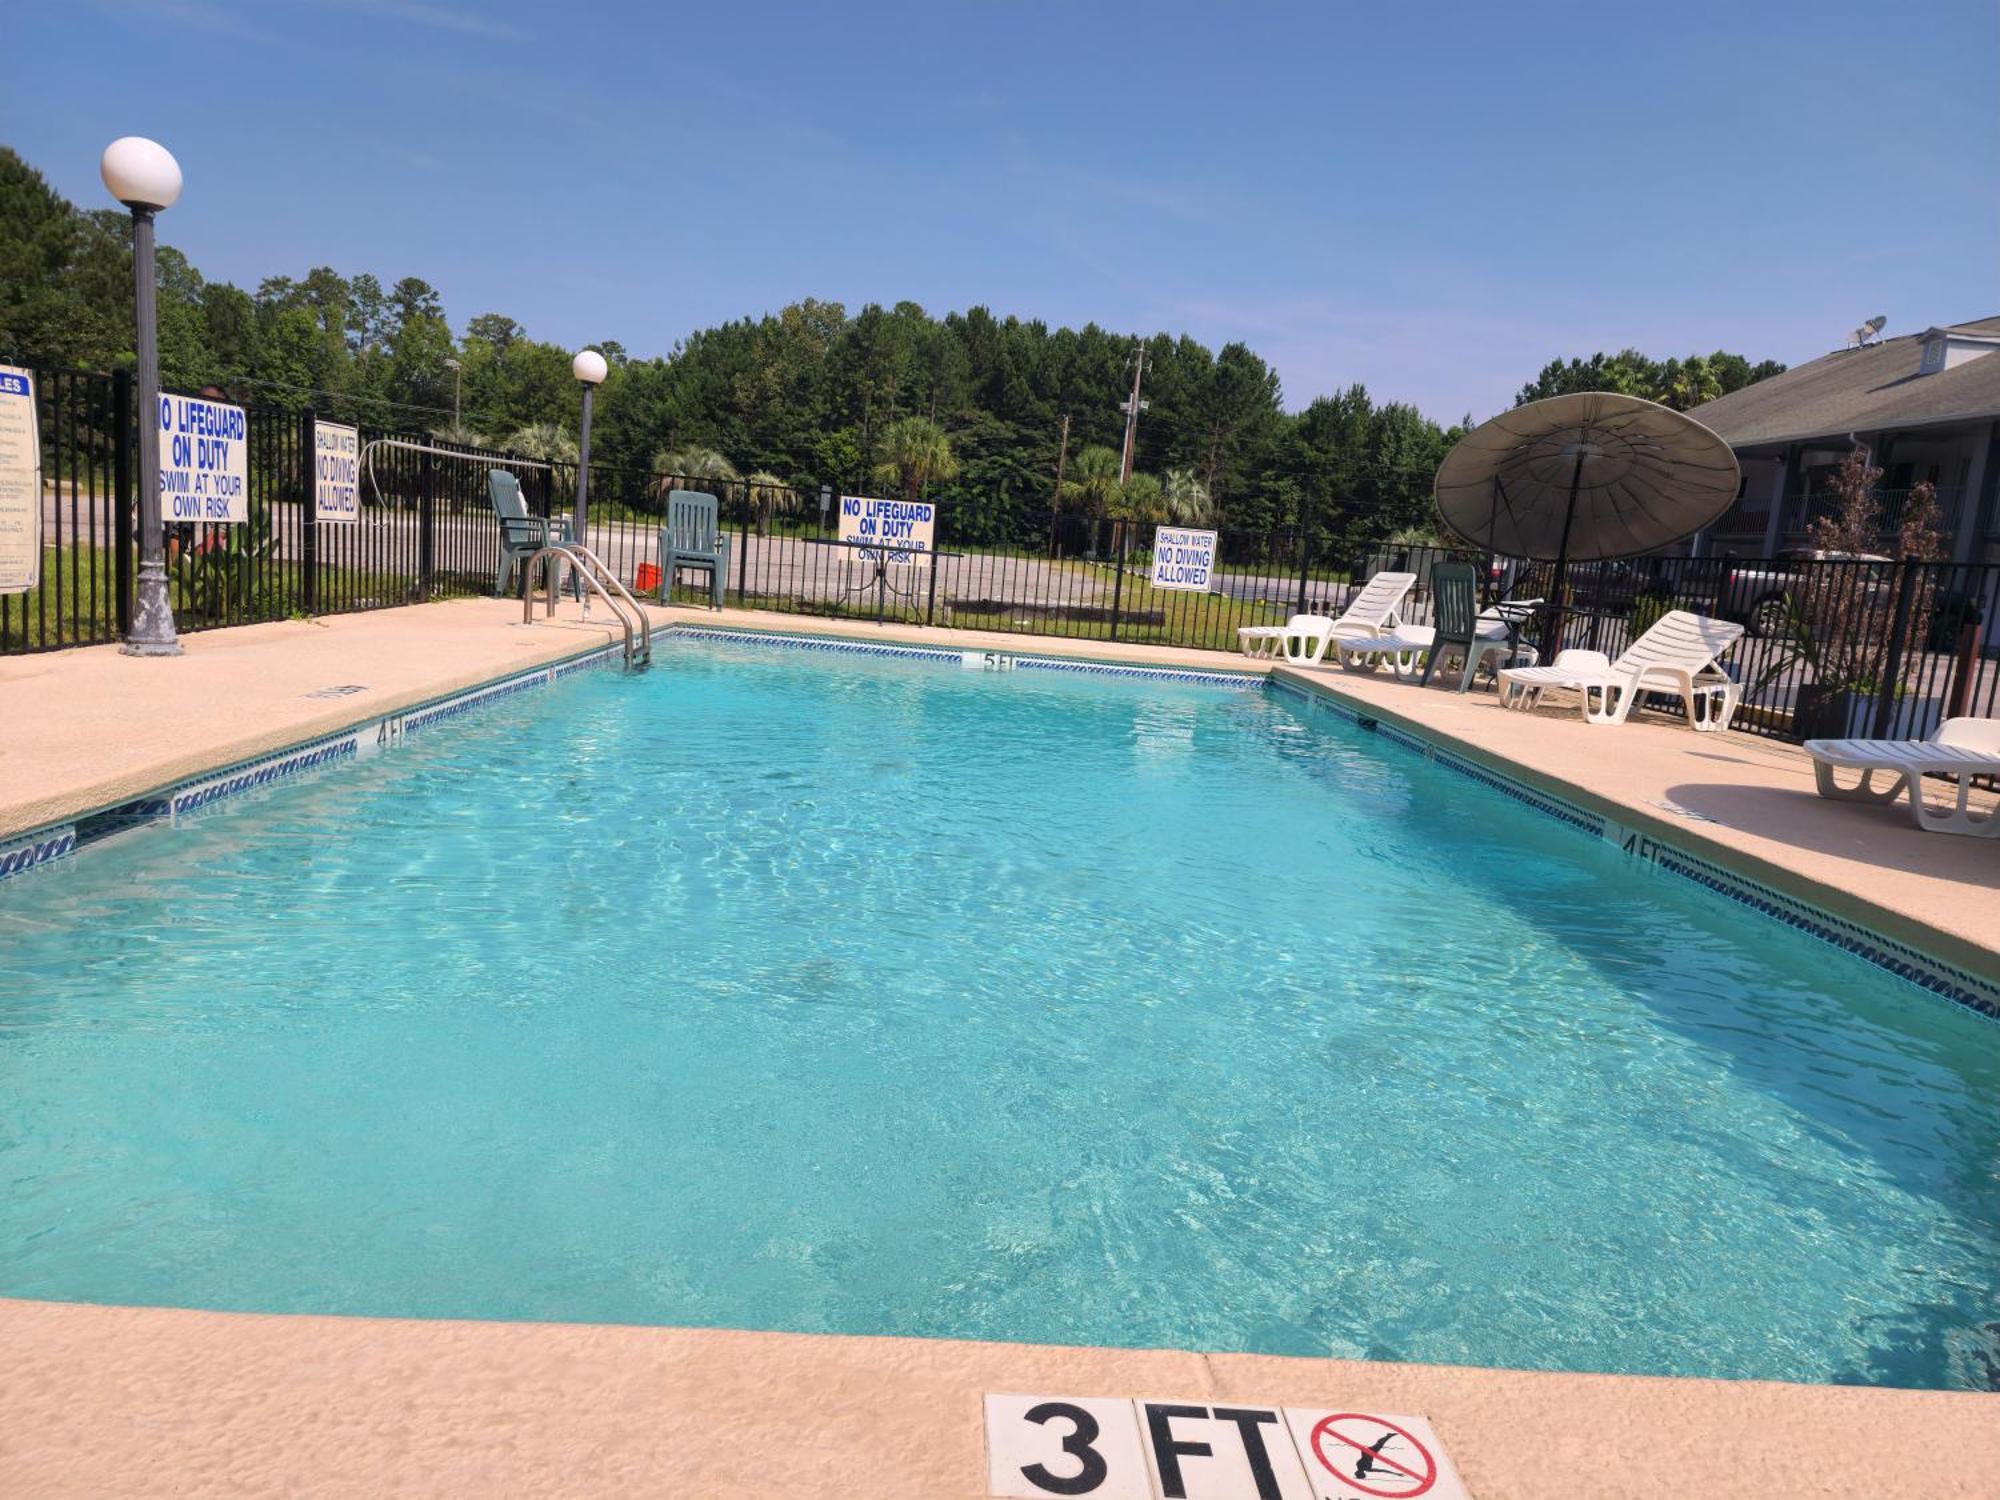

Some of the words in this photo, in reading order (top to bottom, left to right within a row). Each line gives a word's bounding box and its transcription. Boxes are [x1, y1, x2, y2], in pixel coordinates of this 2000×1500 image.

[156, 396, 172, 431] O
[178, 401, 244, 440] LIFEGUARD
[172, 434, 192, 467] ON
[198, 438, 229, 470] DUTY
[317, 454, 328, 481] NO
[330, 456, 356, 484] DIVING
[160, 470, 190, 493] SWIM
[195, 474, 209, 494] AT
[213, 474, 242, 496] YOUR
[173, 495, 201, 517] OWN
[206, 497, 230, 518] RISK
[319, 485, 355, 512] ALLOWED
[843, 498, 861, 516] NO
[866, 501, 932, 523] LIFEGUARD
[859, 517, 877, 536] ON
[882, 520, 914, 538] DUTY
[1160, 532, 1189, 546] SHALLOW
[1191, 535, 1213, 548] WATER
[887, 550, 912, 563] RISK
[1159, 546, 1173, 564] NO
[1176, 548, 1210, 567] DIVING
[1157, 565, 1207, 584] ALLOWED
[1019, 1401, 1108, 1496] 3
[1144, 1403, 1283, 1500] FT
